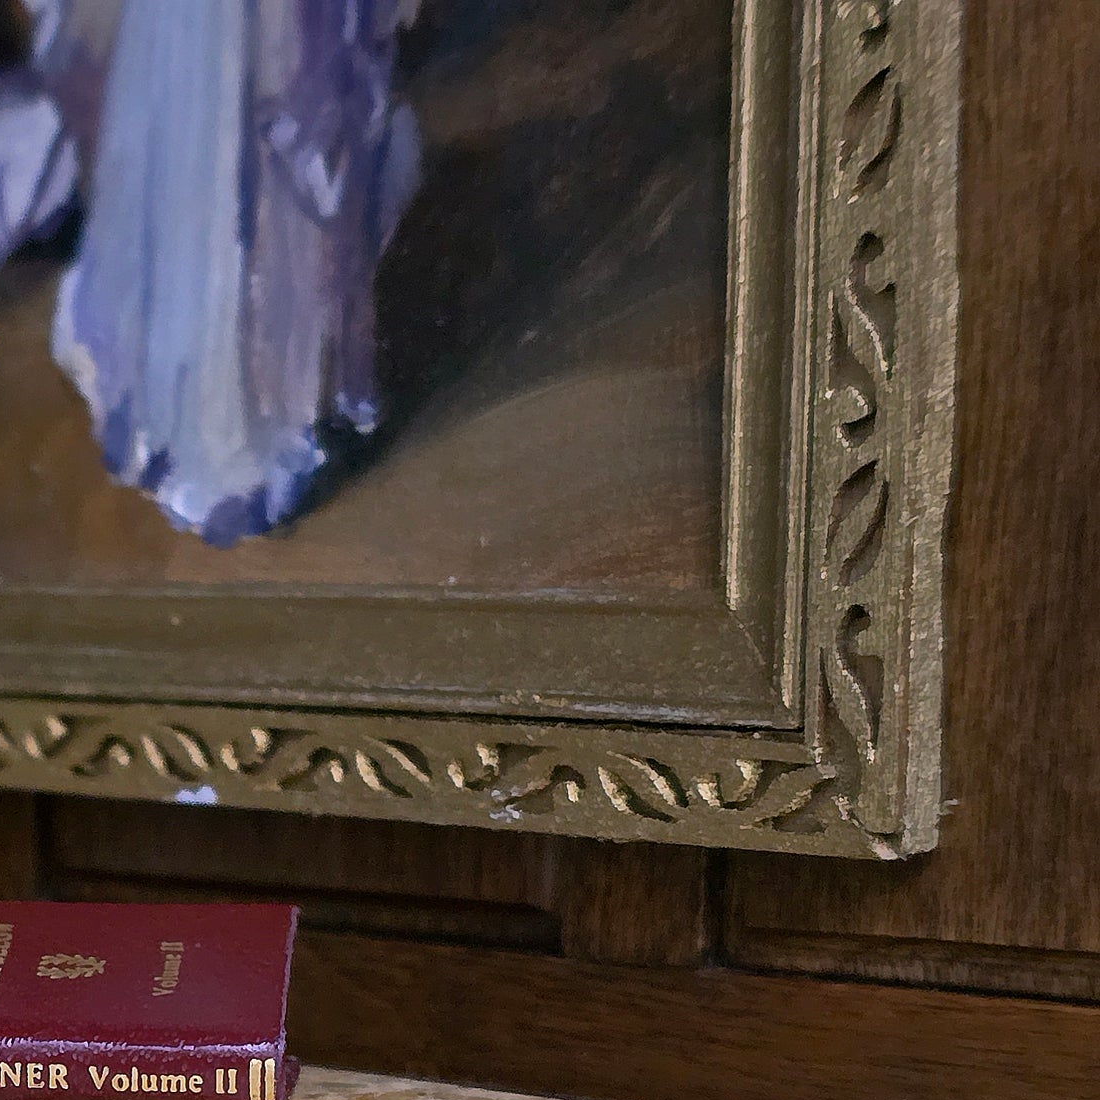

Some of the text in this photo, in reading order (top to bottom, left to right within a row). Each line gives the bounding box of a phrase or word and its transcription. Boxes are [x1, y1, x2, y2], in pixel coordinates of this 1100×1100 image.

[152, 941, 185, 996] Volume II
[88, 1065, 204, 1093] Volume
[215, 1069, 238, 1094] II
